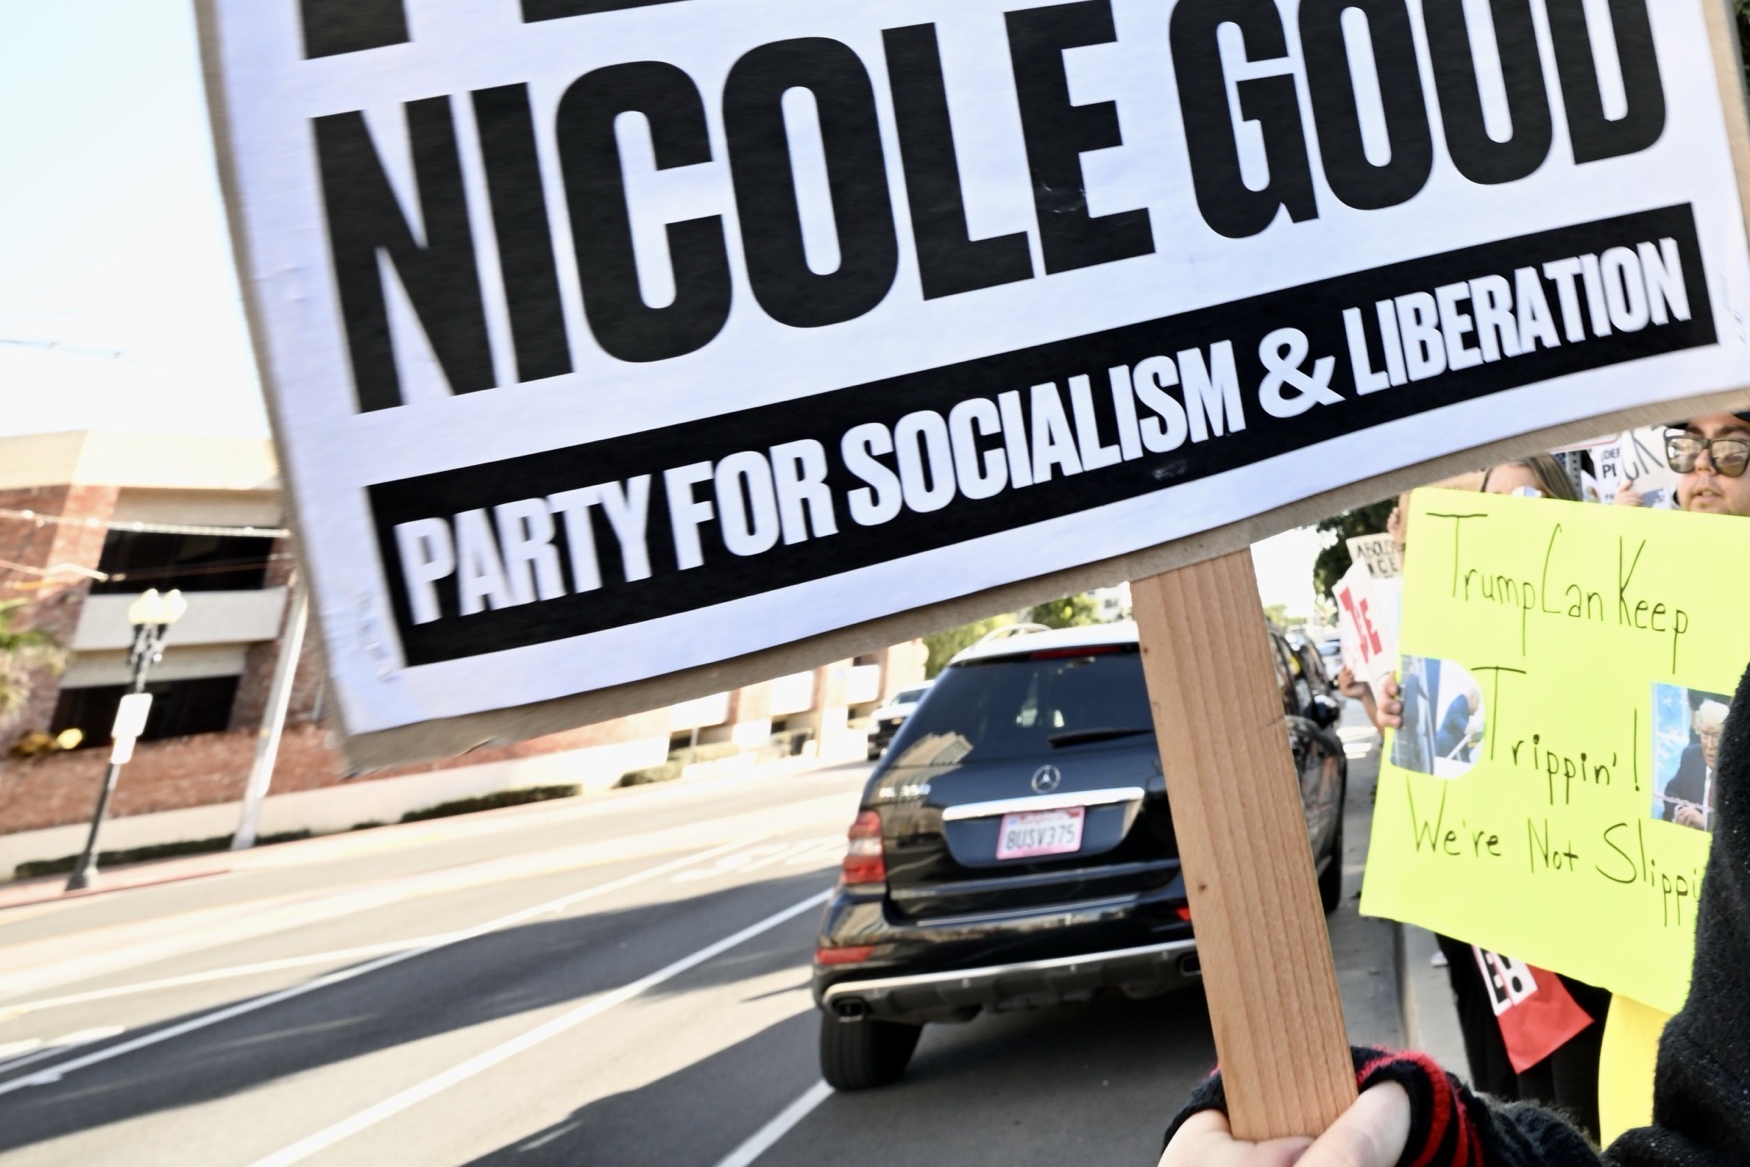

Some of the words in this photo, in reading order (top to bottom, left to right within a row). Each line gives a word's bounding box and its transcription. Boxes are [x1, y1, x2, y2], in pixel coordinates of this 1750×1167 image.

[393, 474, 655, 624] PARTY
[668, 444, 842, 569] FOR
[841, 338, 1246, 528] SOCIALISM
[1257, 326, 1348, 419] &
[1342, 235, 1691, 392] LIBERATION
[1426, 511, 1537, 657] Trump
[1541, 522, 1605, 622] Can
[1619, 534, 1690, 675] Keep
[1406, 776, 1502, 857] We're
[1527, 817, 1580, 874] Not
